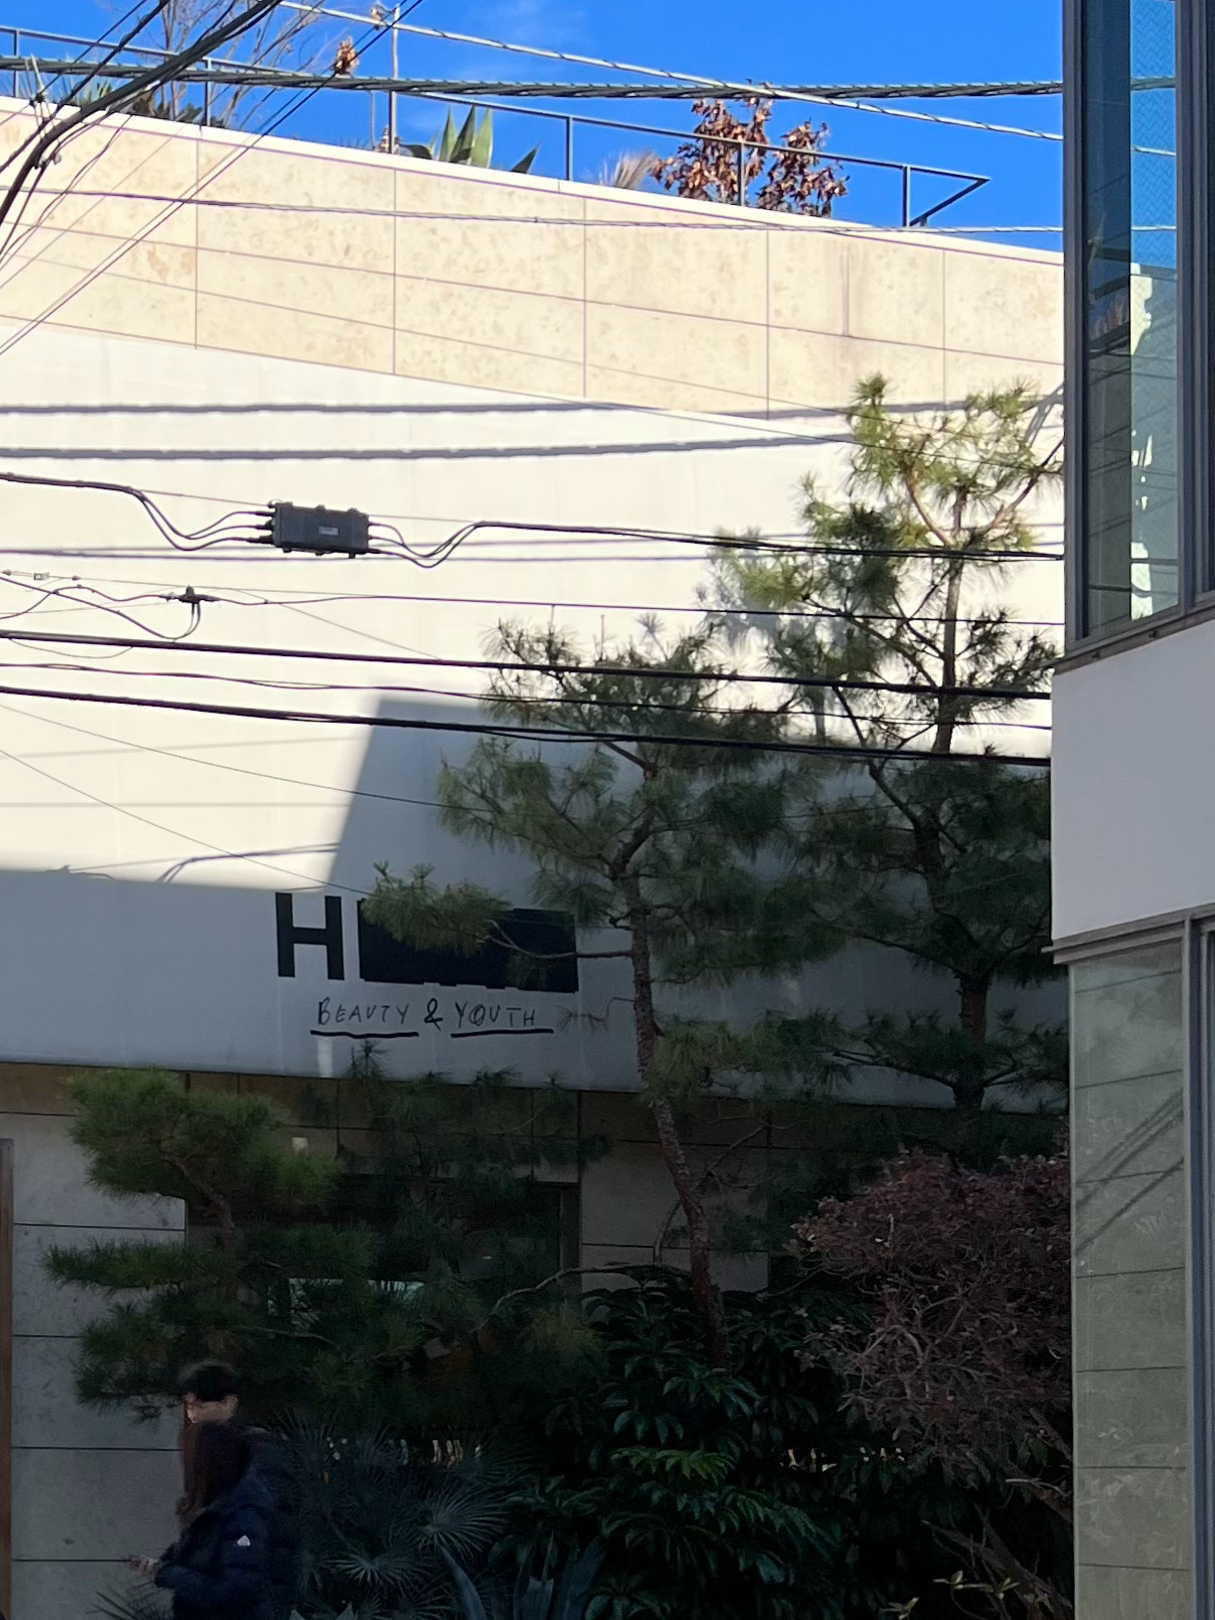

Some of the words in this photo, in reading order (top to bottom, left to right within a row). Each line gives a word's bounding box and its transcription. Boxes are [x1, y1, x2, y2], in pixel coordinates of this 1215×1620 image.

[275, 892, 345, 981] H
[317, 997, 410, 1026] BEAUTY
[424, 998, 443, 1031] &
[454, 1000, 536, 1027] YOUTH
